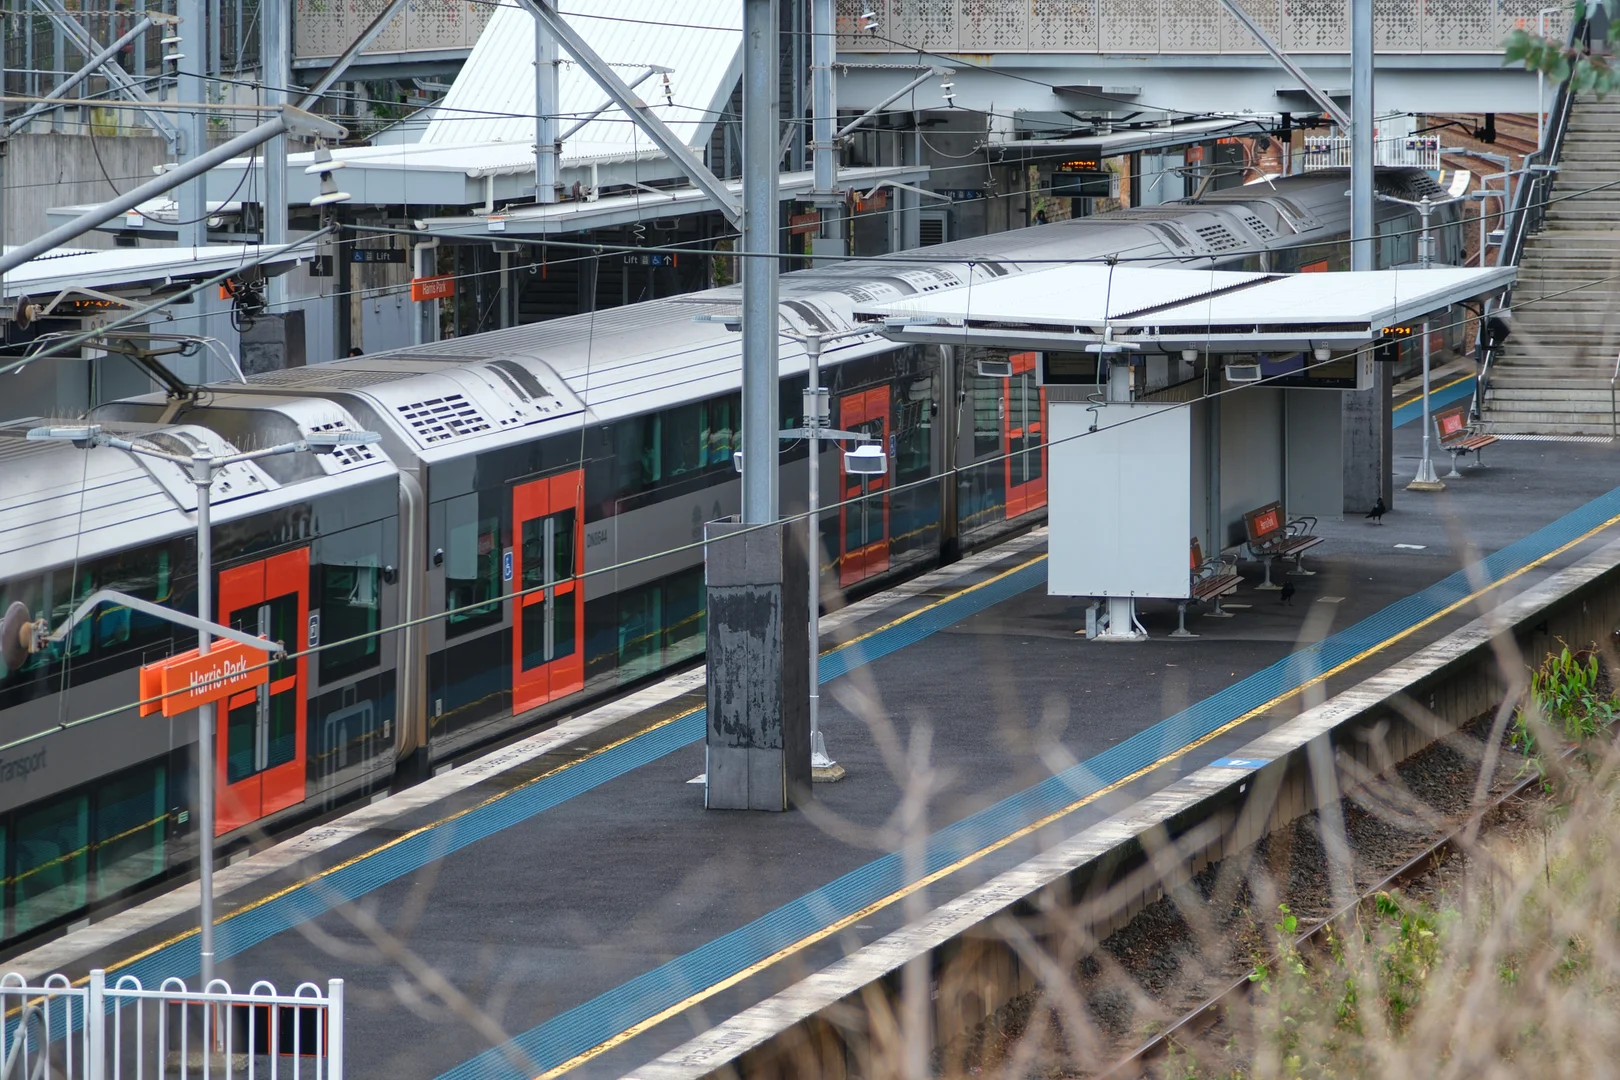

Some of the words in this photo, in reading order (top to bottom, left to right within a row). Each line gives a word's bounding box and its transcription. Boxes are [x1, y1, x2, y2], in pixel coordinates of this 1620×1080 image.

[376, 252, 391, 260] Lift
[623, 255, 638, 264] Lift
[529, 262, 537, 274] 3
[190, 664, 222, 697] Harris
[224, 655, 248, 685] Park
